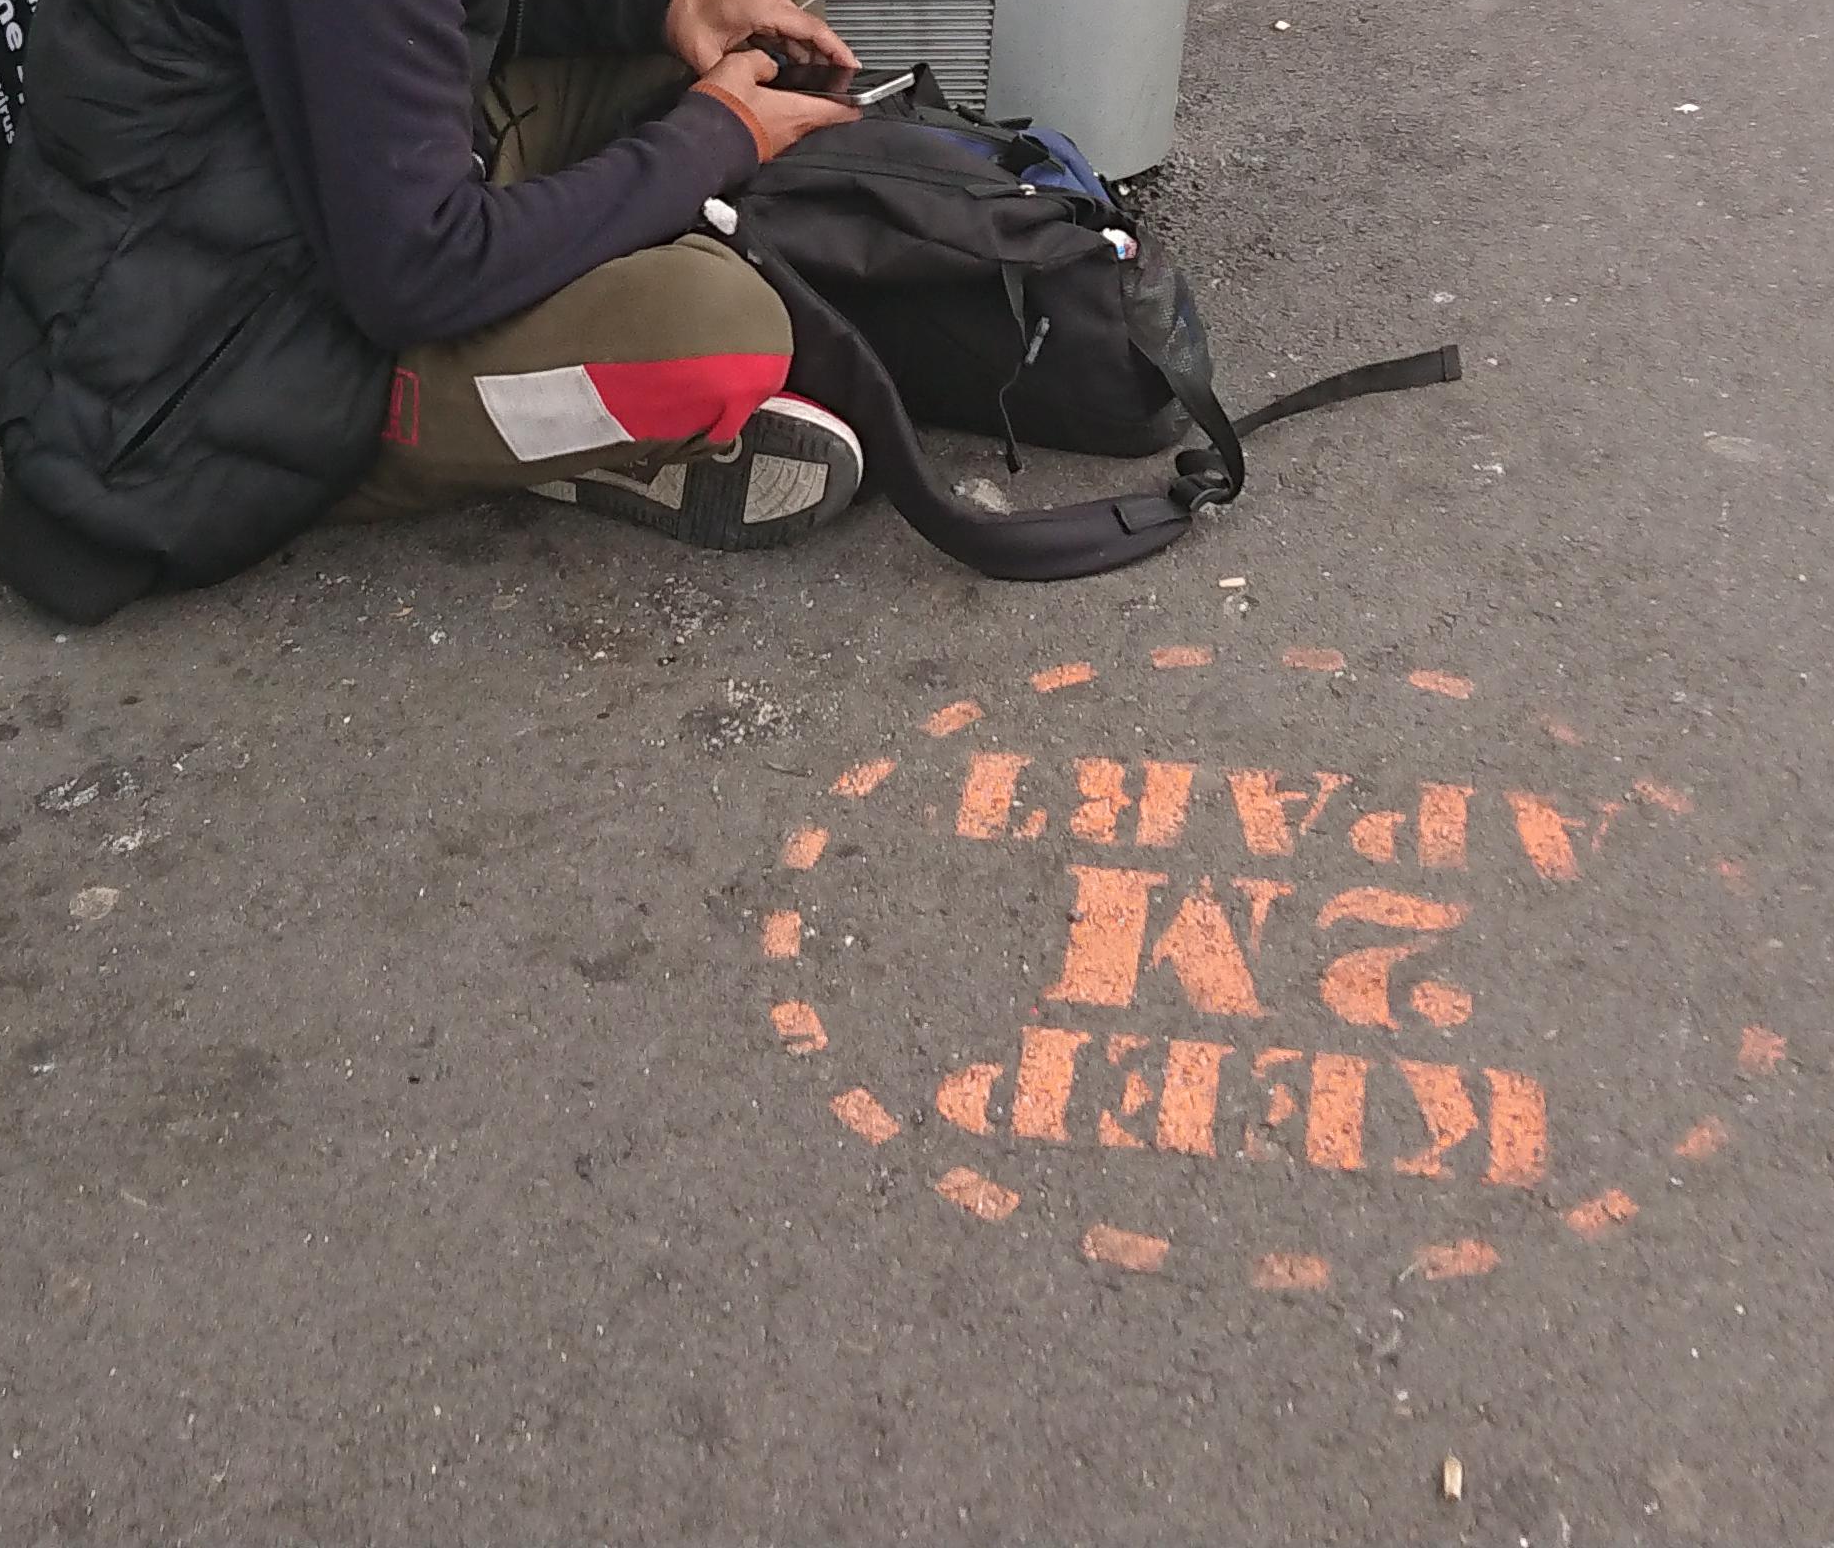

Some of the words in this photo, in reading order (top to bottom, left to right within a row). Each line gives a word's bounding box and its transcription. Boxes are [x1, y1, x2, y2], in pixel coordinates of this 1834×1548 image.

[955, 752, 1625, 883] APART
[1044, 863, 1474, 1031] 2M
[934, 1025, 1550, 1190] KEEP
